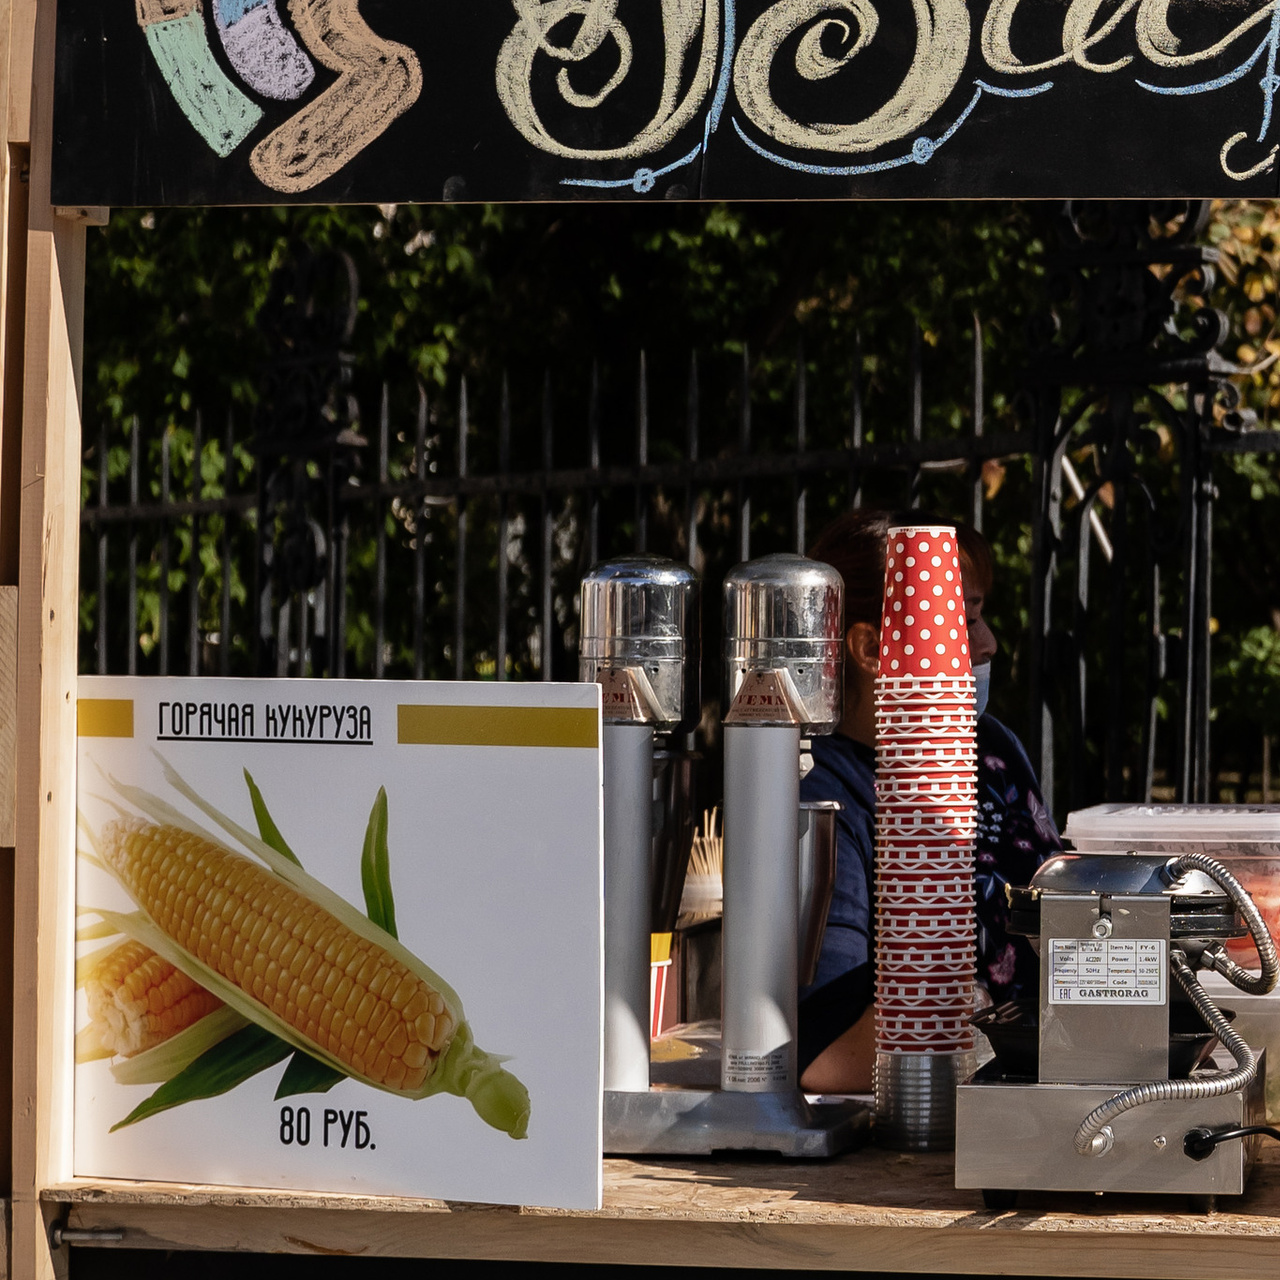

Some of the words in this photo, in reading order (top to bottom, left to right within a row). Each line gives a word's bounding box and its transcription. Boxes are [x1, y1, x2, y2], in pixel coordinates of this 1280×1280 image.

[158, 701, 255, 737] ГОРЯЧАЯ
[265, 703, 372, 740] КУКУРУЗА
[1079, 989, 1149, 998] GASTRORAG
[280, 1106, 311, 1146] 80
[323, 1108, 376, 1151] РУБ.
